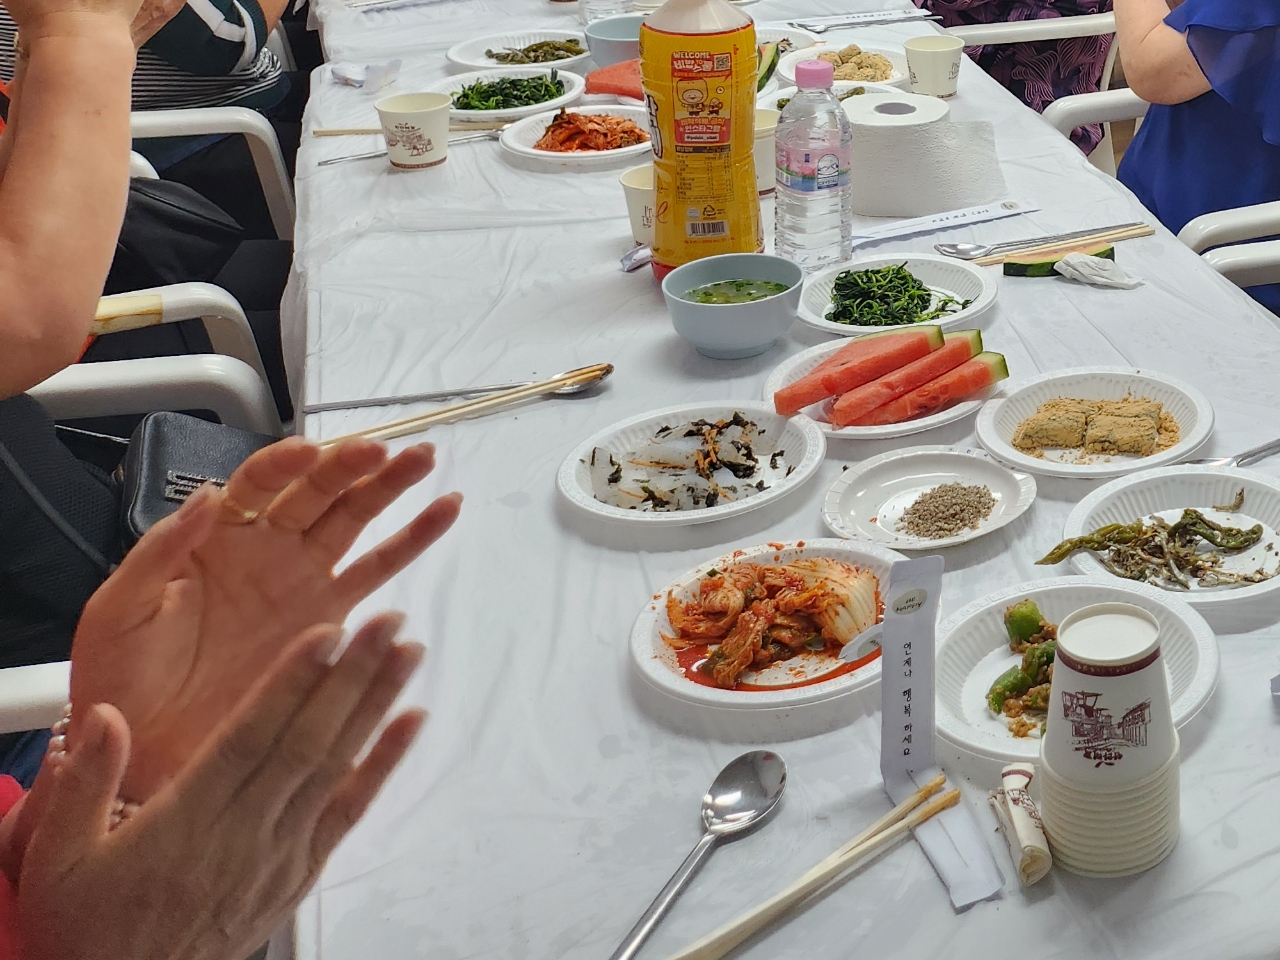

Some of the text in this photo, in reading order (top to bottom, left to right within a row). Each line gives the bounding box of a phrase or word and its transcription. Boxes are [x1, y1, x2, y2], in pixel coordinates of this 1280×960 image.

[902, 641, 913, 756] 언제나 행복 하세요
